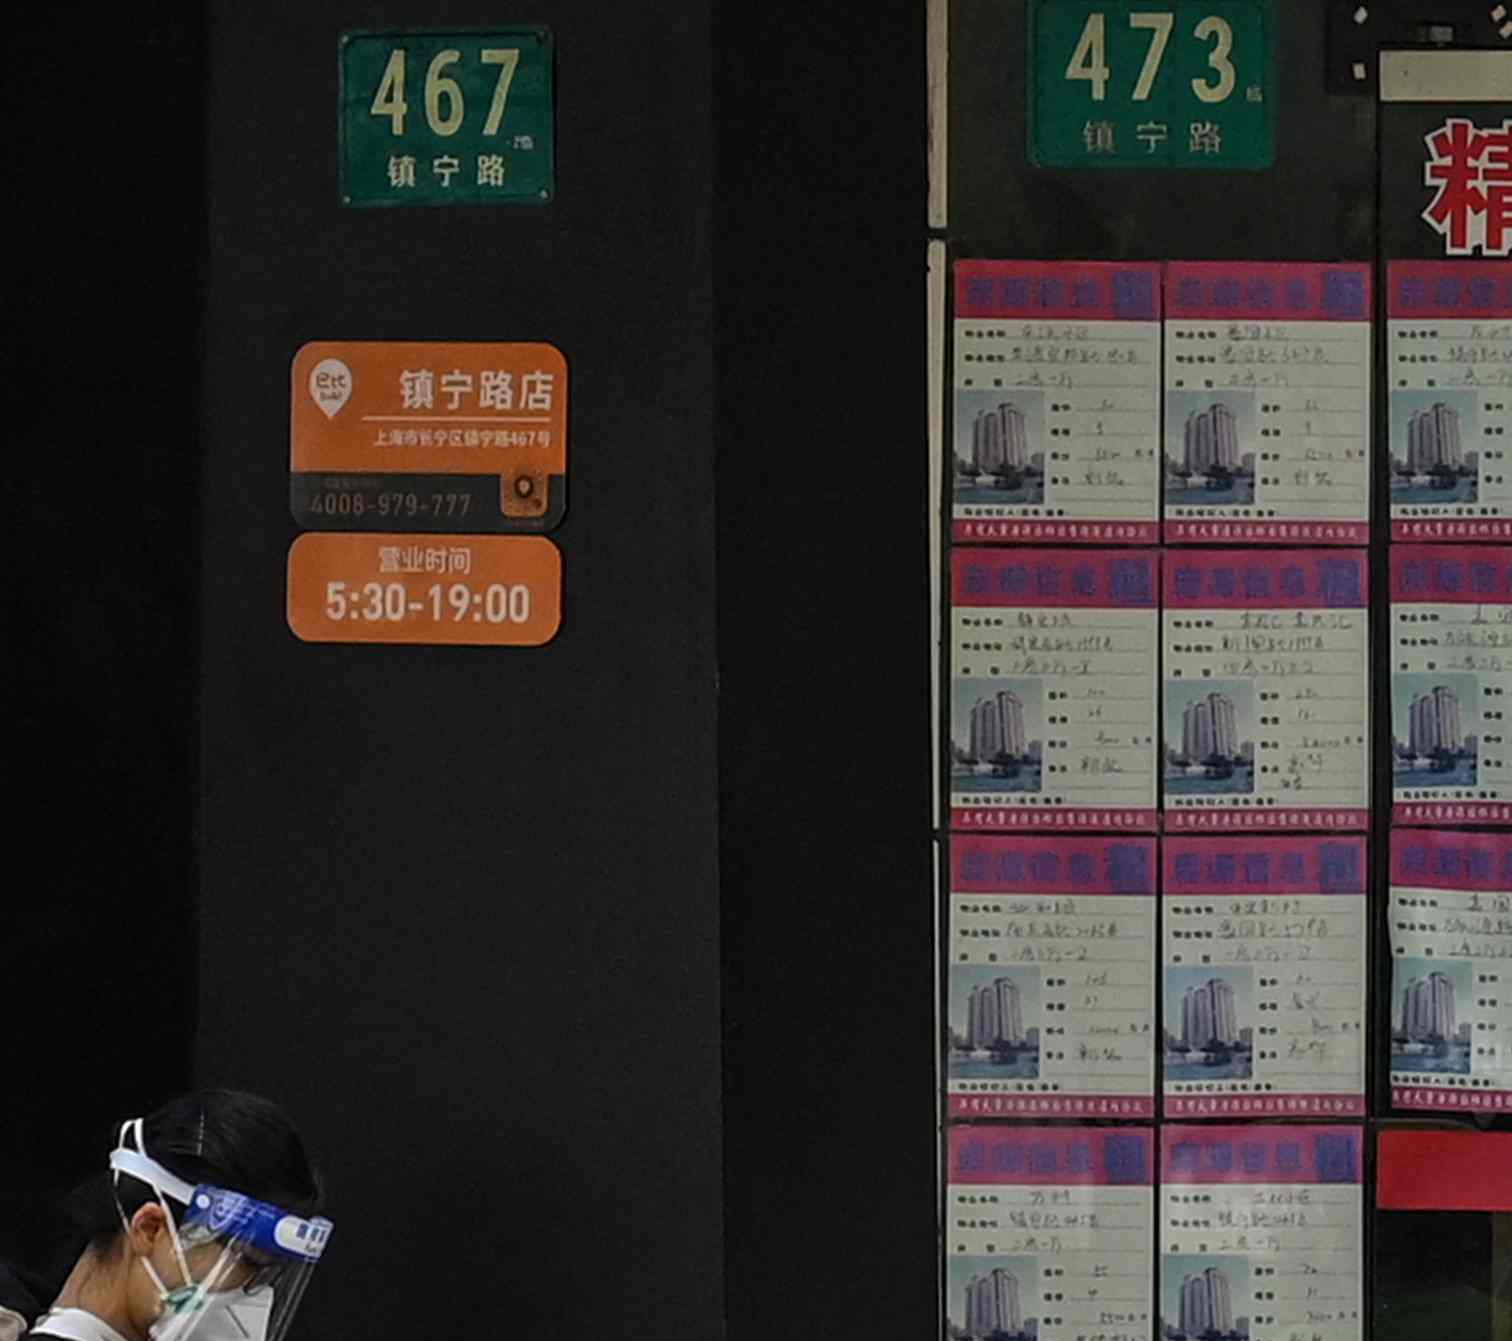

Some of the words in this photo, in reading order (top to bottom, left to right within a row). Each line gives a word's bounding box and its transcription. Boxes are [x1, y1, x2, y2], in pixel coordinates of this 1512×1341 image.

[1065, 13, 1236, 103] 473
[371, 49, 520, 136] 467
[1083, 120, 1221, 153] 镇宁路
[387, 155, 505, 187] 镇宁路
[400, 370, 554, 411] 镇宁路店
[378, 546, 471, 575] 营业时间
[326, 582, 529, 624] 5:30-19:00
